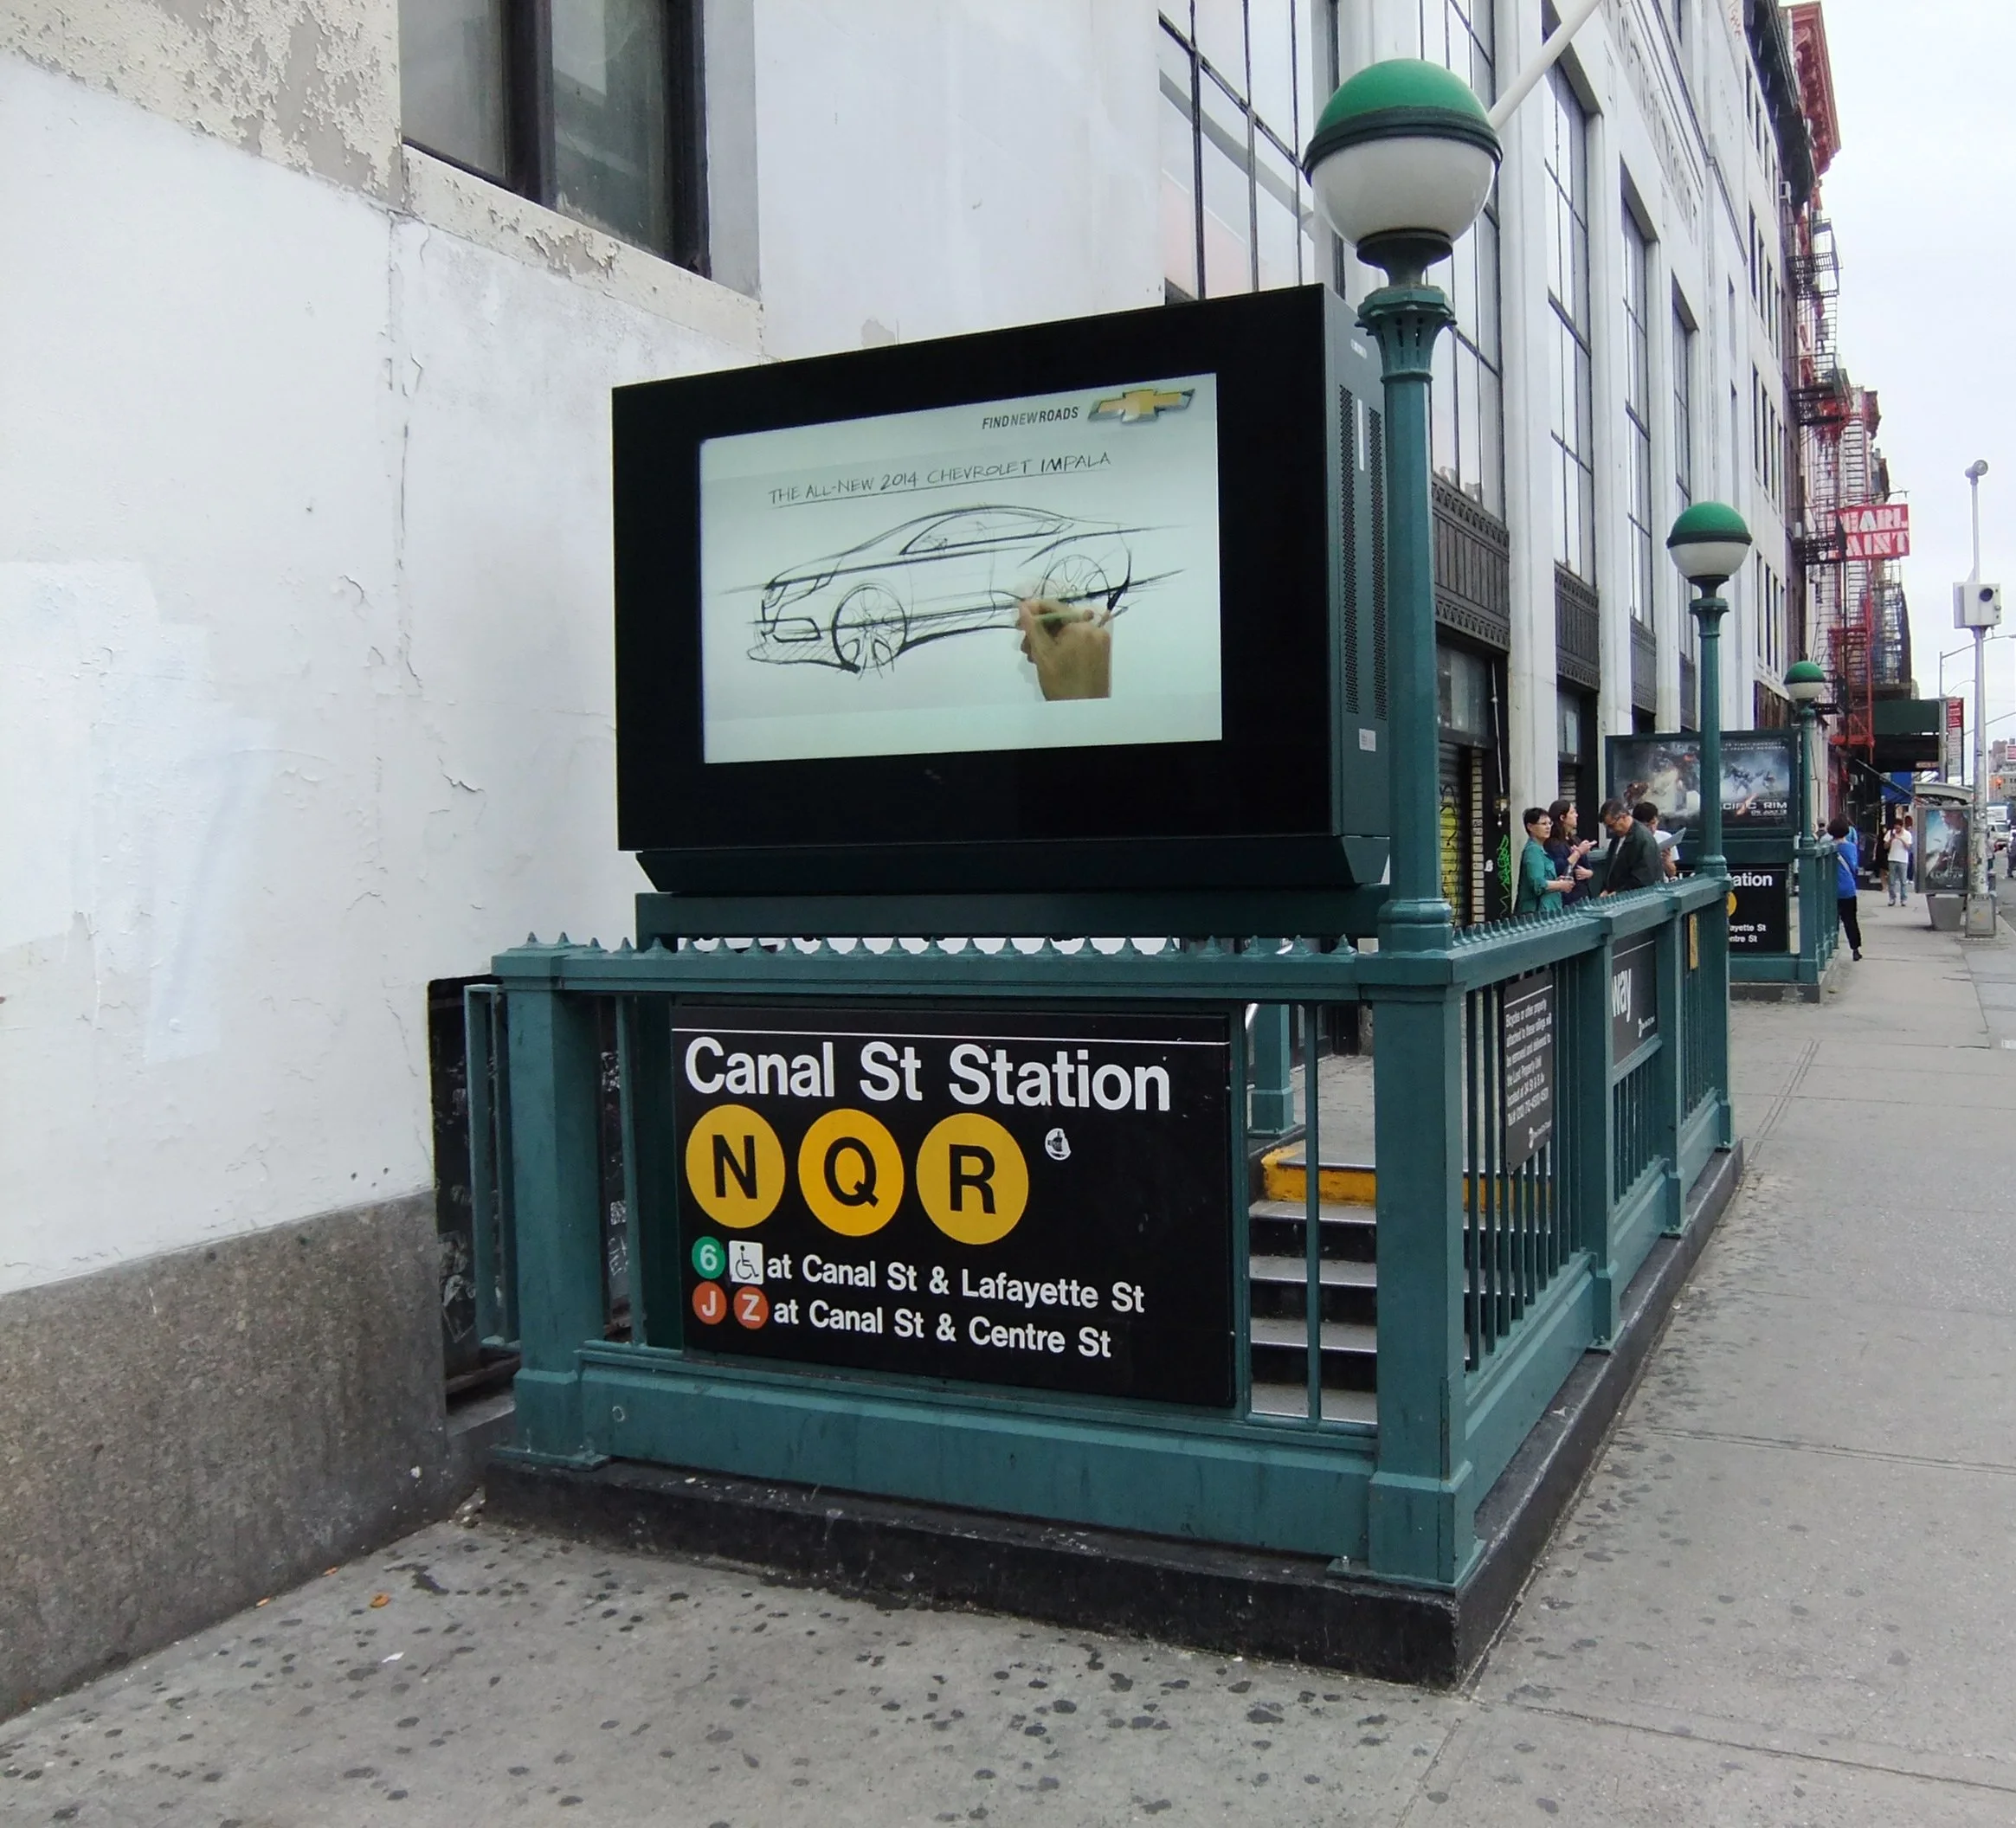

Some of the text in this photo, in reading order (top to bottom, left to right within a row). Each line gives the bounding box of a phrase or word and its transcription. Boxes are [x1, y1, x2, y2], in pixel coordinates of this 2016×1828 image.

[769, 451, 1111, 505] THE ALL-NEW 2014 CHEVROLET IMPALA
[1827, 531, 1910, 557] AINT
[1748, 934, 1758, 943] St
[1756, 923, 1767, 932] St
[686, 1036, 1170, 1111] Canal St Station
[713, 1135, 996, 1214] N Q R
[699, 1244, 1145, 1315] 6 at Canal St & Lafayette St
[702, 1291, 1111, 1359] J Z at Canal St & Centre St
